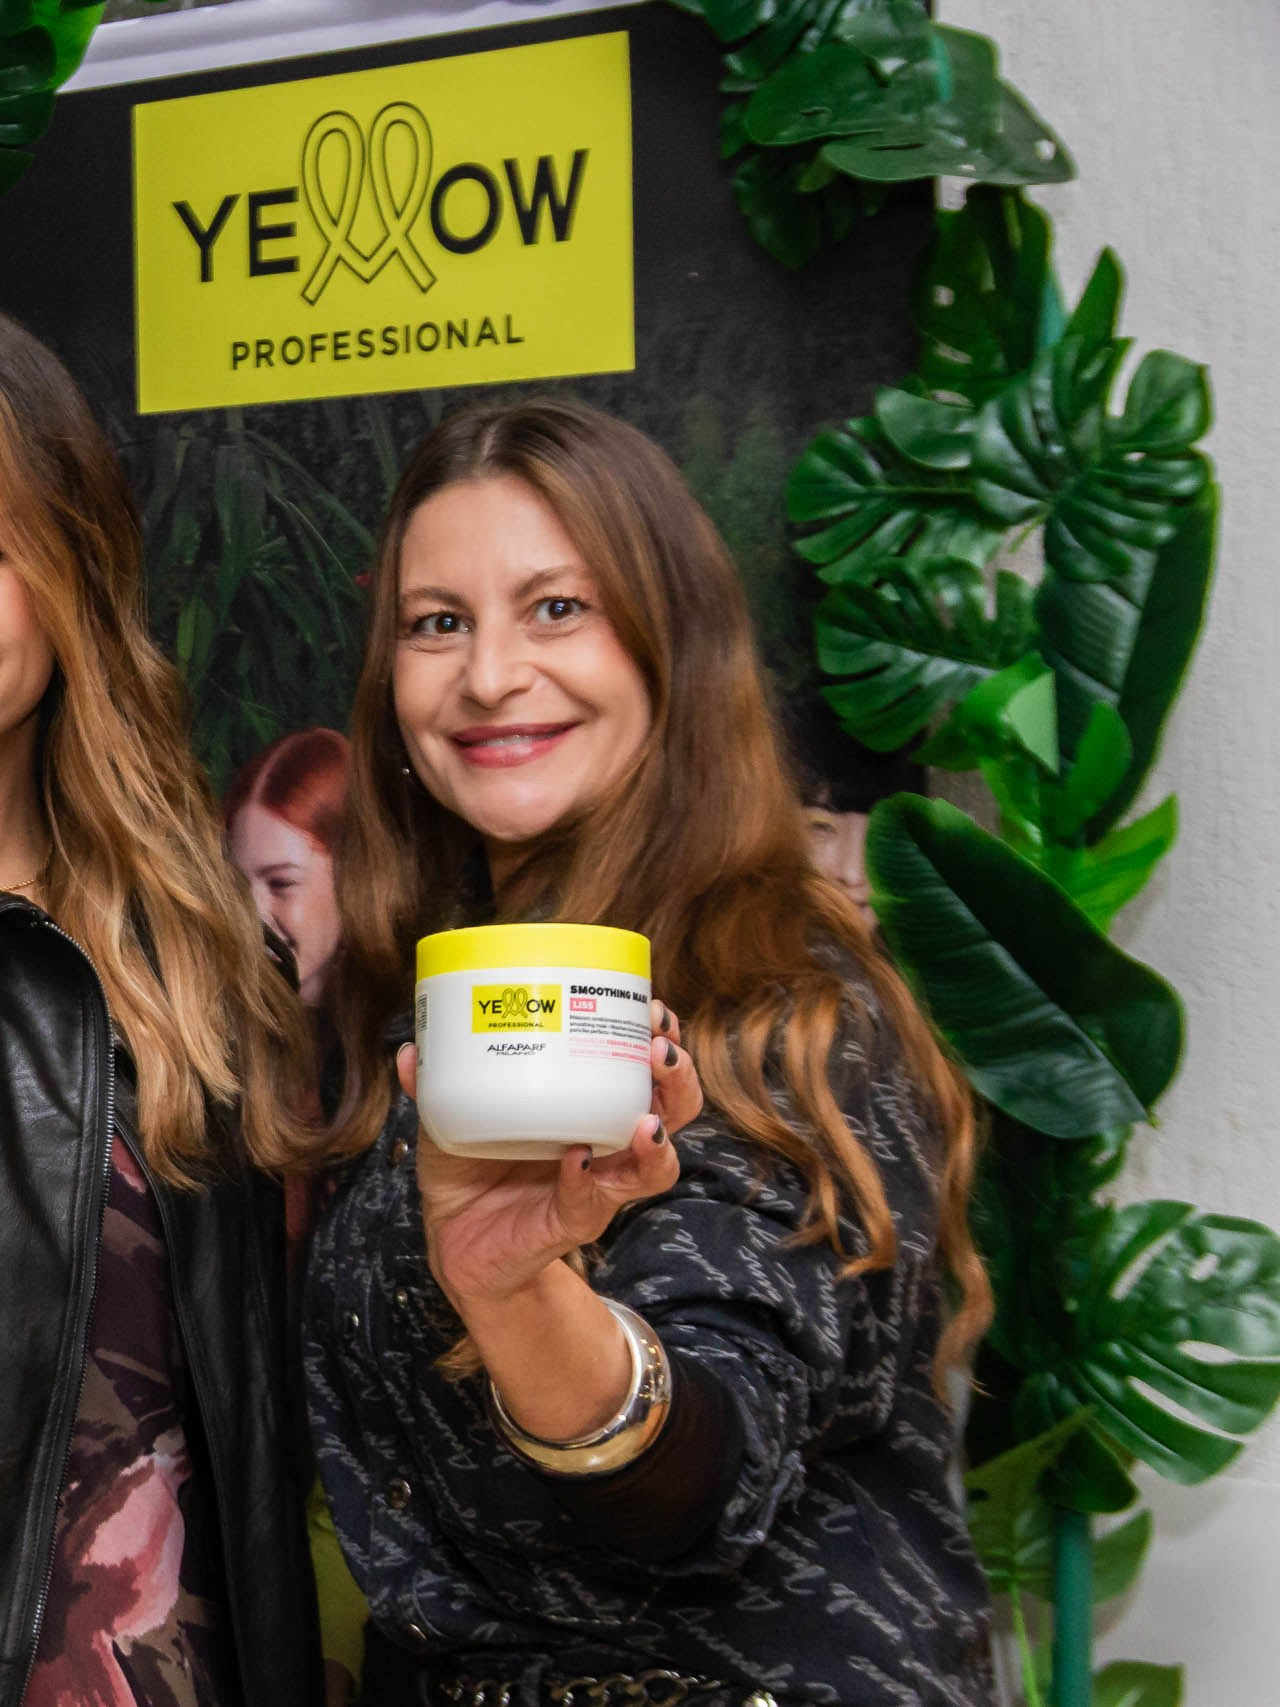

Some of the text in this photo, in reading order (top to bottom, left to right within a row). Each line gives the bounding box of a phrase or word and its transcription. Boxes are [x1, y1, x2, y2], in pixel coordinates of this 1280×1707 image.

[172, 101, 590, 306] YELLOW
[231, 313, 526, 371] PROFESSIONAL
[478, 988, 556, 1019] YELLOW
[570, 985, 631, 1000] SMOOTHING
[573, 1000, 594, 1008] LISS
[487, 1043, 546, 1052] ALFAPARF
